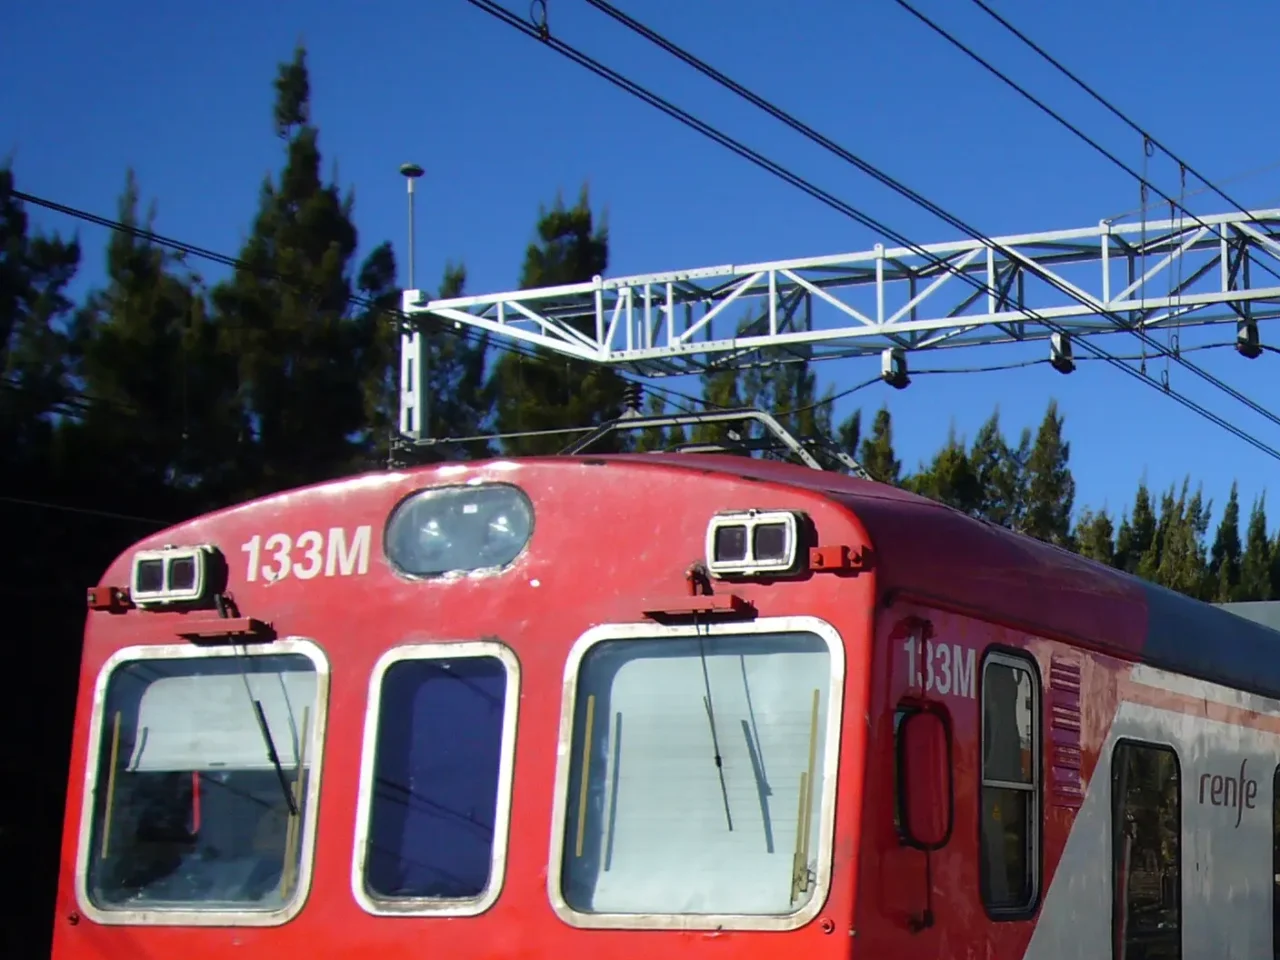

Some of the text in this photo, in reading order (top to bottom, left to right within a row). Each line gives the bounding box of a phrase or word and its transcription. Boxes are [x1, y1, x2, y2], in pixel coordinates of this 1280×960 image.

[241, 525, 372, 582] 133M
[903, 635, 976, 699] 133M
[1199, 758, 1257, 829] renfe
